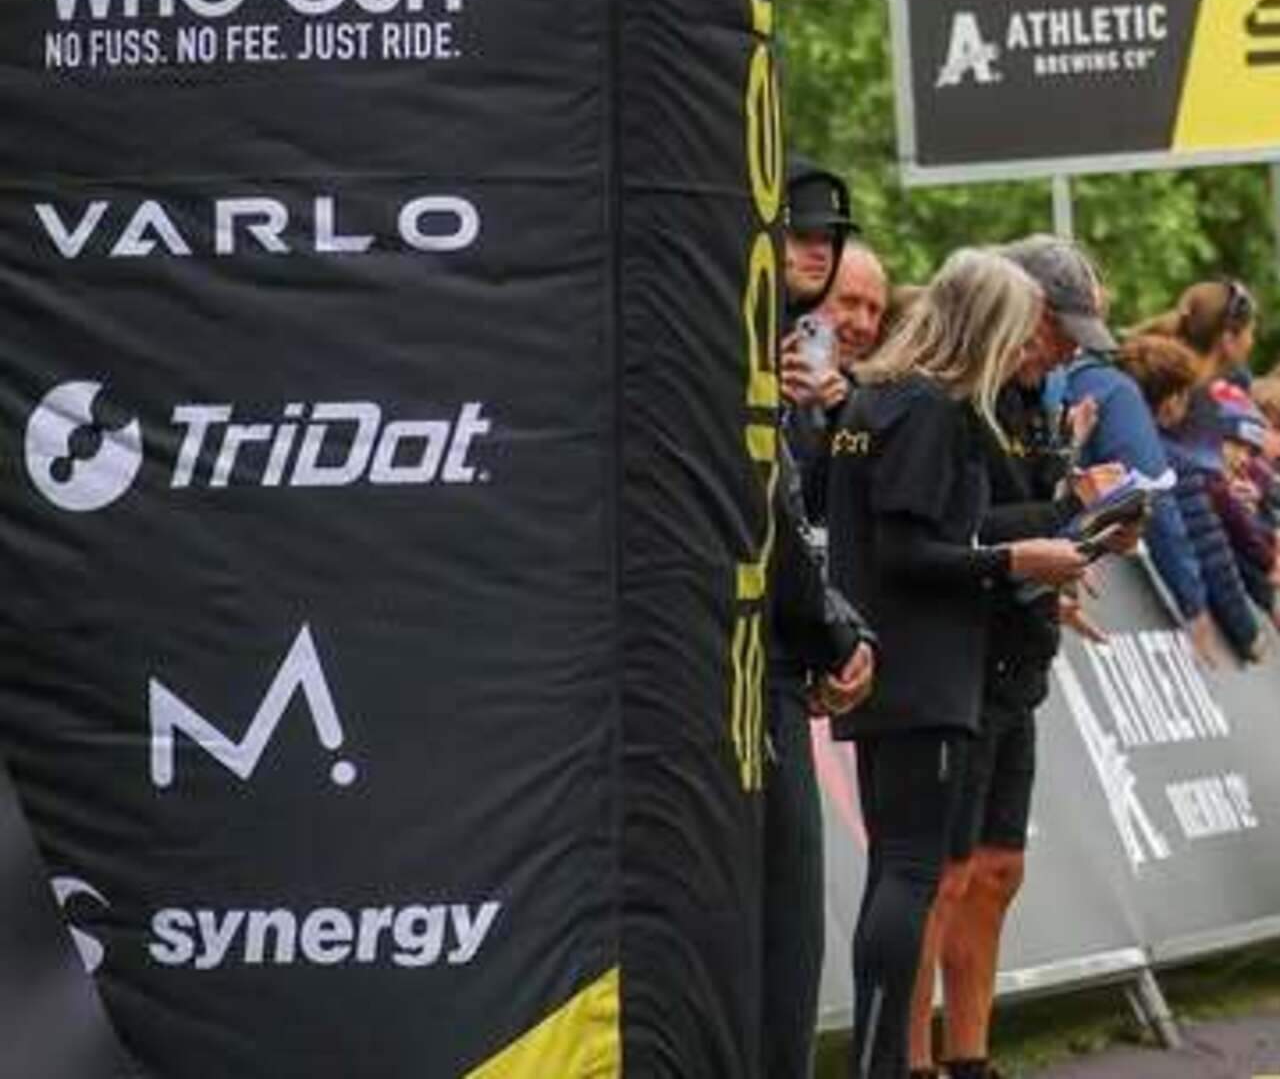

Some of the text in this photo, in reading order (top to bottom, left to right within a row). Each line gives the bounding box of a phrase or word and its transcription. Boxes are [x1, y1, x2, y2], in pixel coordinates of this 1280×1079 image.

[45, 22, 461, 69] NO FUSS. NO FEE. JUST RIDE.
[1006, 1, 1168, 49] ATHLETIC
[34, 195, 482, 259] VARLO
[170, 401, 490, 488] TriDot
[149, 900, 501, 970] synergy
